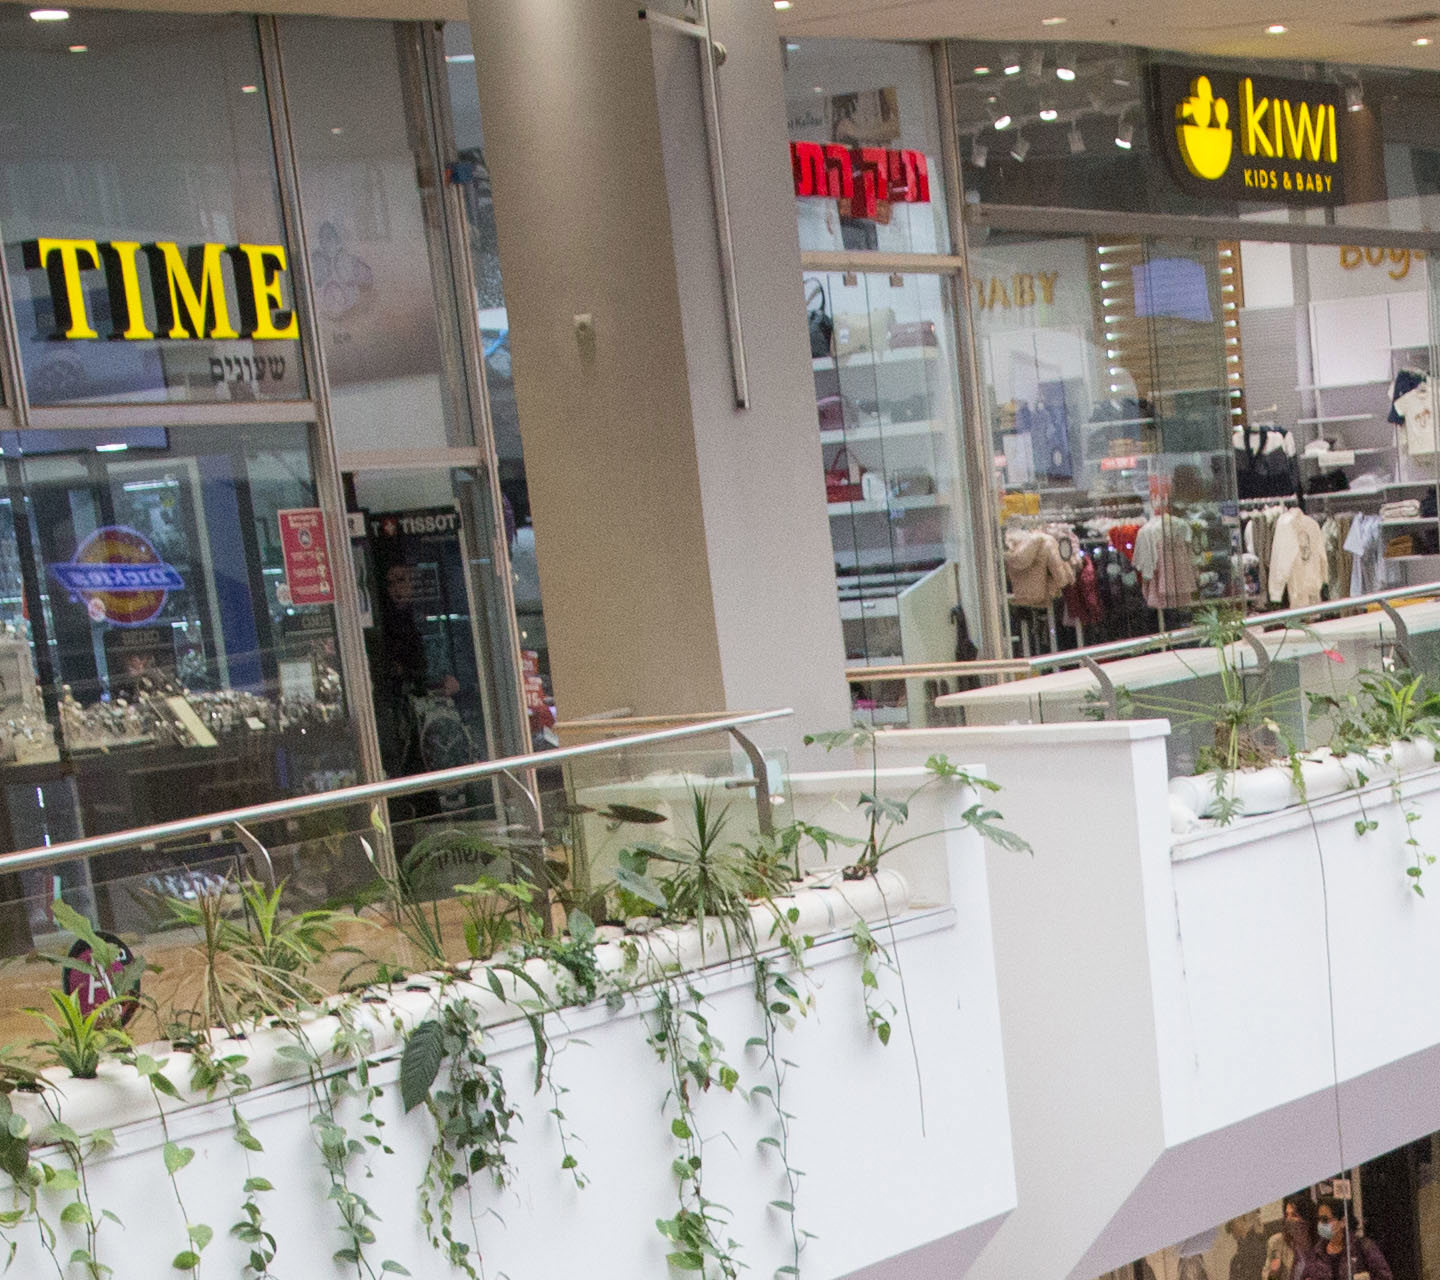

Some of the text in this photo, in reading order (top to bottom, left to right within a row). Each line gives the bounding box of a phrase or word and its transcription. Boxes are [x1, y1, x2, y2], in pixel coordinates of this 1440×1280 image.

[789, 140, 855, 198] הת
[1244, 168, 1332, 192] KIDS & BABY
[35, 238, 300, 340] TIME
[208, 356, 287, 386] שעונים
[400, 513, 459, 535] TISSOT
